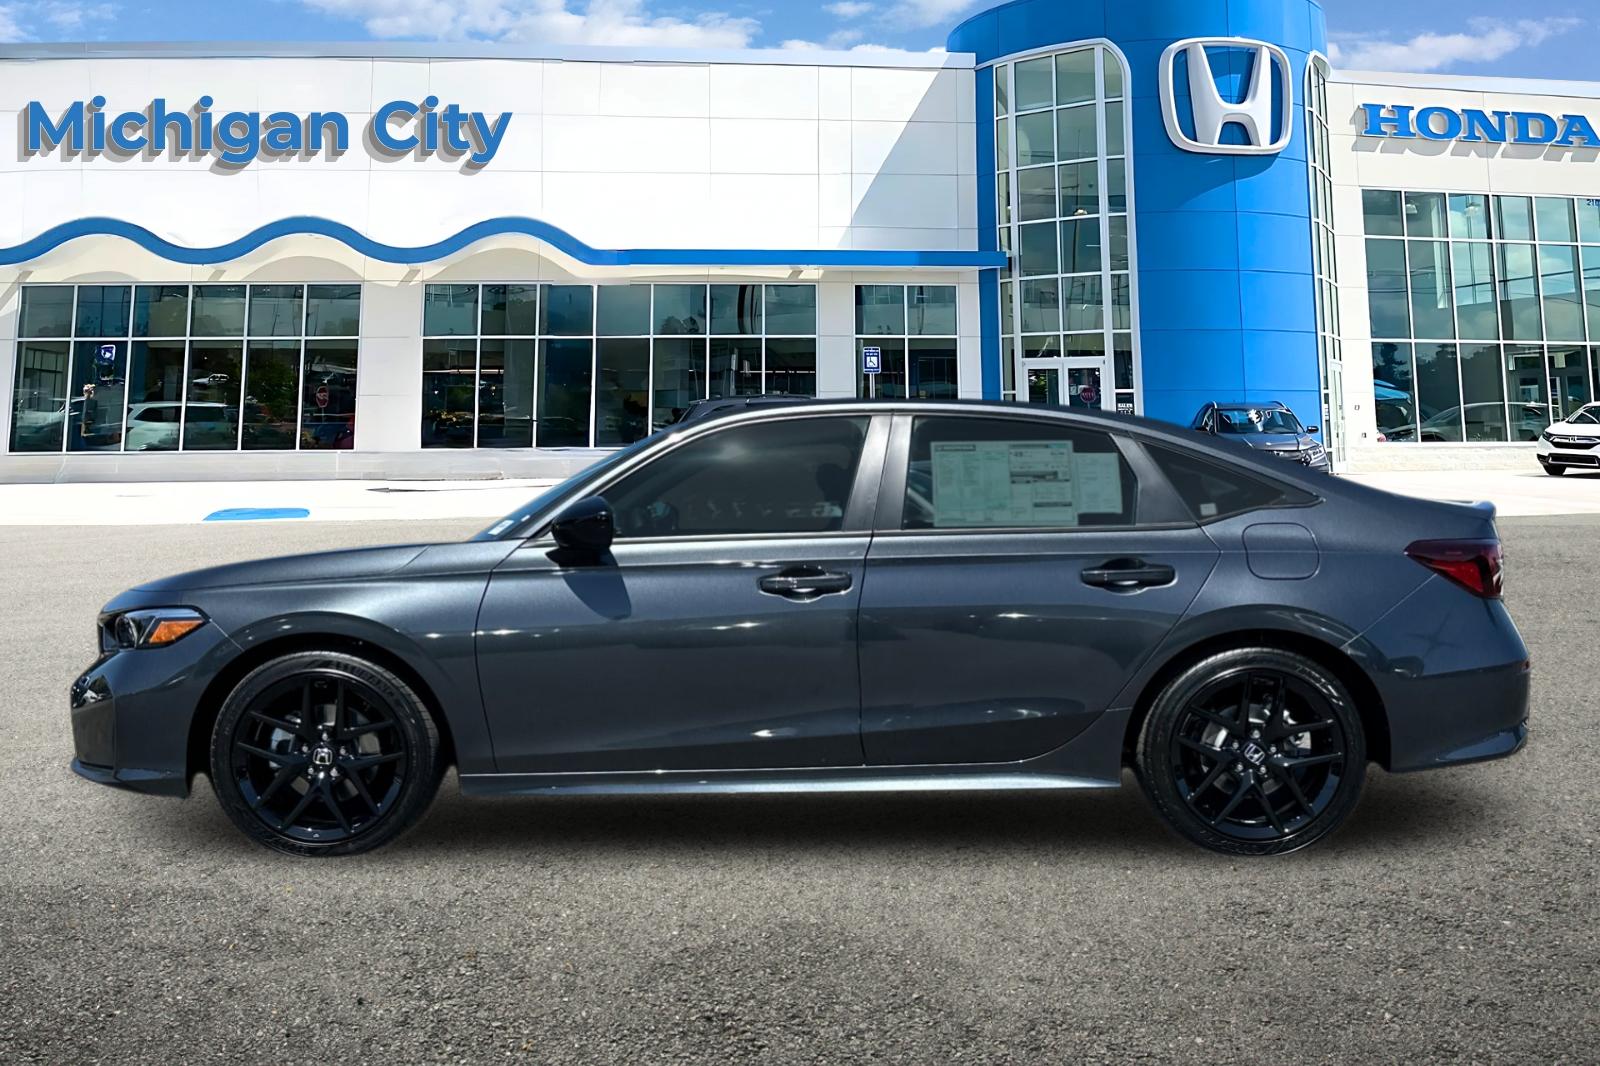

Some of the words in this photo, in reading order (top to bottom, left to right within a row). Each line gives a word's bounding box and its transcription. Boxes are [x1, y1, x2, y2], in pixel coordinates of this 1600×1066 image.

[28, 95, 349, 164] Michigan
[373, 95, 513, 164] City
[1362, 103, 1600, 146] HONDA
